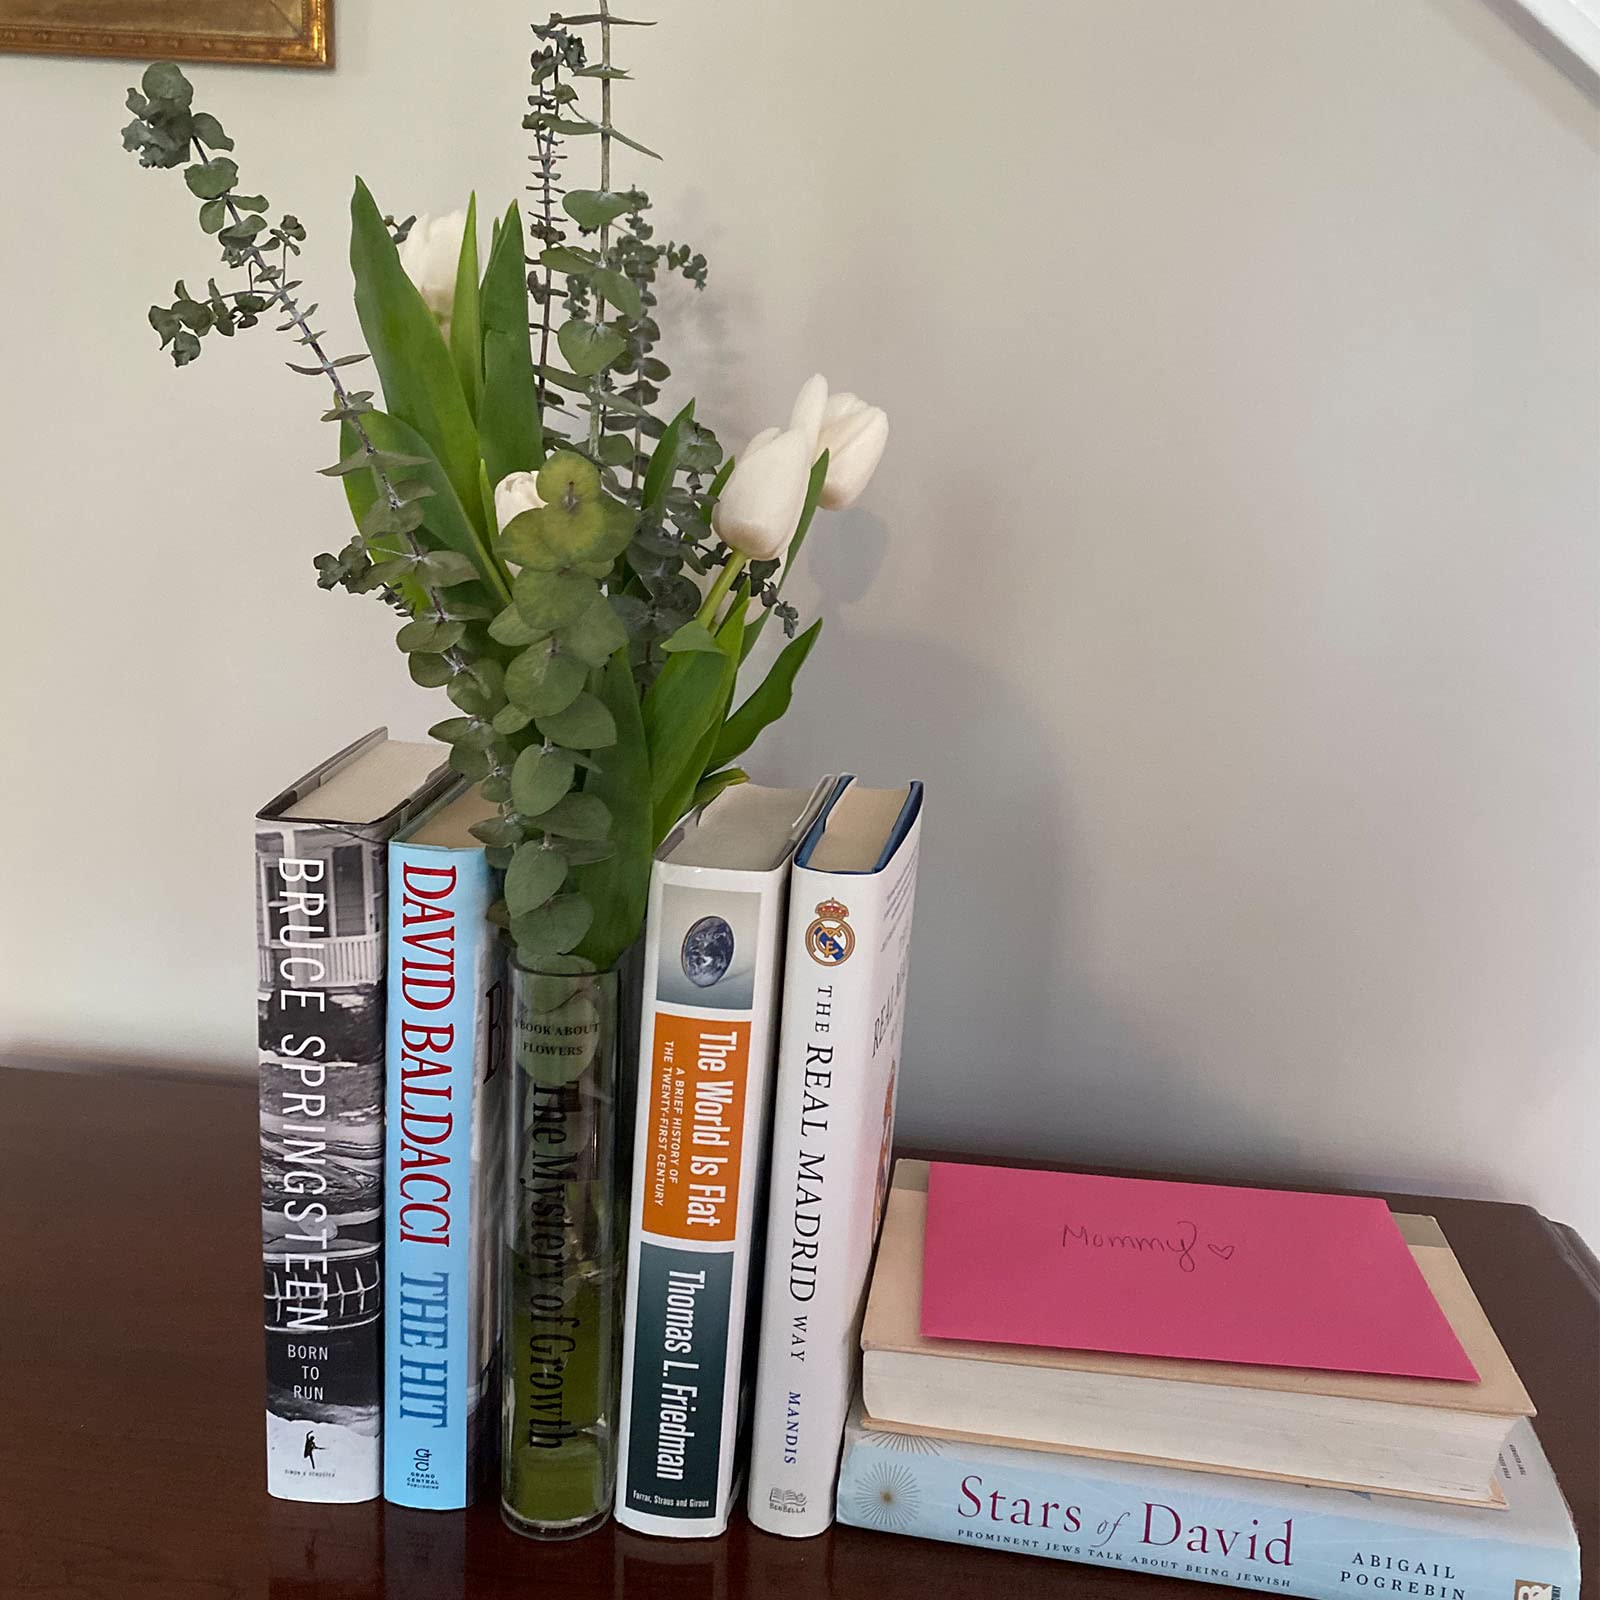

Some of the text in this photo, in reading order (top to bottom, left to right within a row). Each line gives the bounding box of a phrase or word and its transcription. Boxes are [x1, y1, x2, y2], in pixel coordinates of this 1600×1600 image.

[399, 861, 457, 1249] DAVID BALDACCI
[522, 1041, 584, 1057] FLOWERS
[555, 1022, 601, 1037] ABOUT
[278, 857, 329, 1331] BRUCE SPRINGSTEEN
[654, 1040, 674, 1207] THE TWENTY-FIRST CENTURY
[668, 1067, 686, 1184] A BRIEF HISTORY OF
[686, 1031, 738, 1227] The World Is Flat
[789, 985, 834, 1362] THE REAL MADRID WAY
[519, 1151, 578, 1289] Mystery
[1062, 1220, 1198, 1273] Mommy
[530, 1293, 581, 1329] of
[287, 1343, 329, 1361] BORN
[301, 1365, 320, 1380] TO
[399, 1271, 450, 1428] THE HIT
[656, 1270, 706, 1482] Thomas L. Friedman
[293, 1385, 324, 1401] RUN
[529, 1333, 578, 1449] Growth
[783, 1391, 801, 1465] MANDIS
[654, 1495, 674, 1507] Straus
[676, 1499, 688, 1508] and
[689, 1498, 709, 1508] Giroux
[957, 1475, 1294, 1567] Stars of David
[957, 1528, 1293, 1588] PROMINENT JEWS TALK ABOUT BEING JEWISH
[1340, 1571, 1466, 1600] POGREBIN
[1351, 1552, 1456, 1580] ABIGAIL
